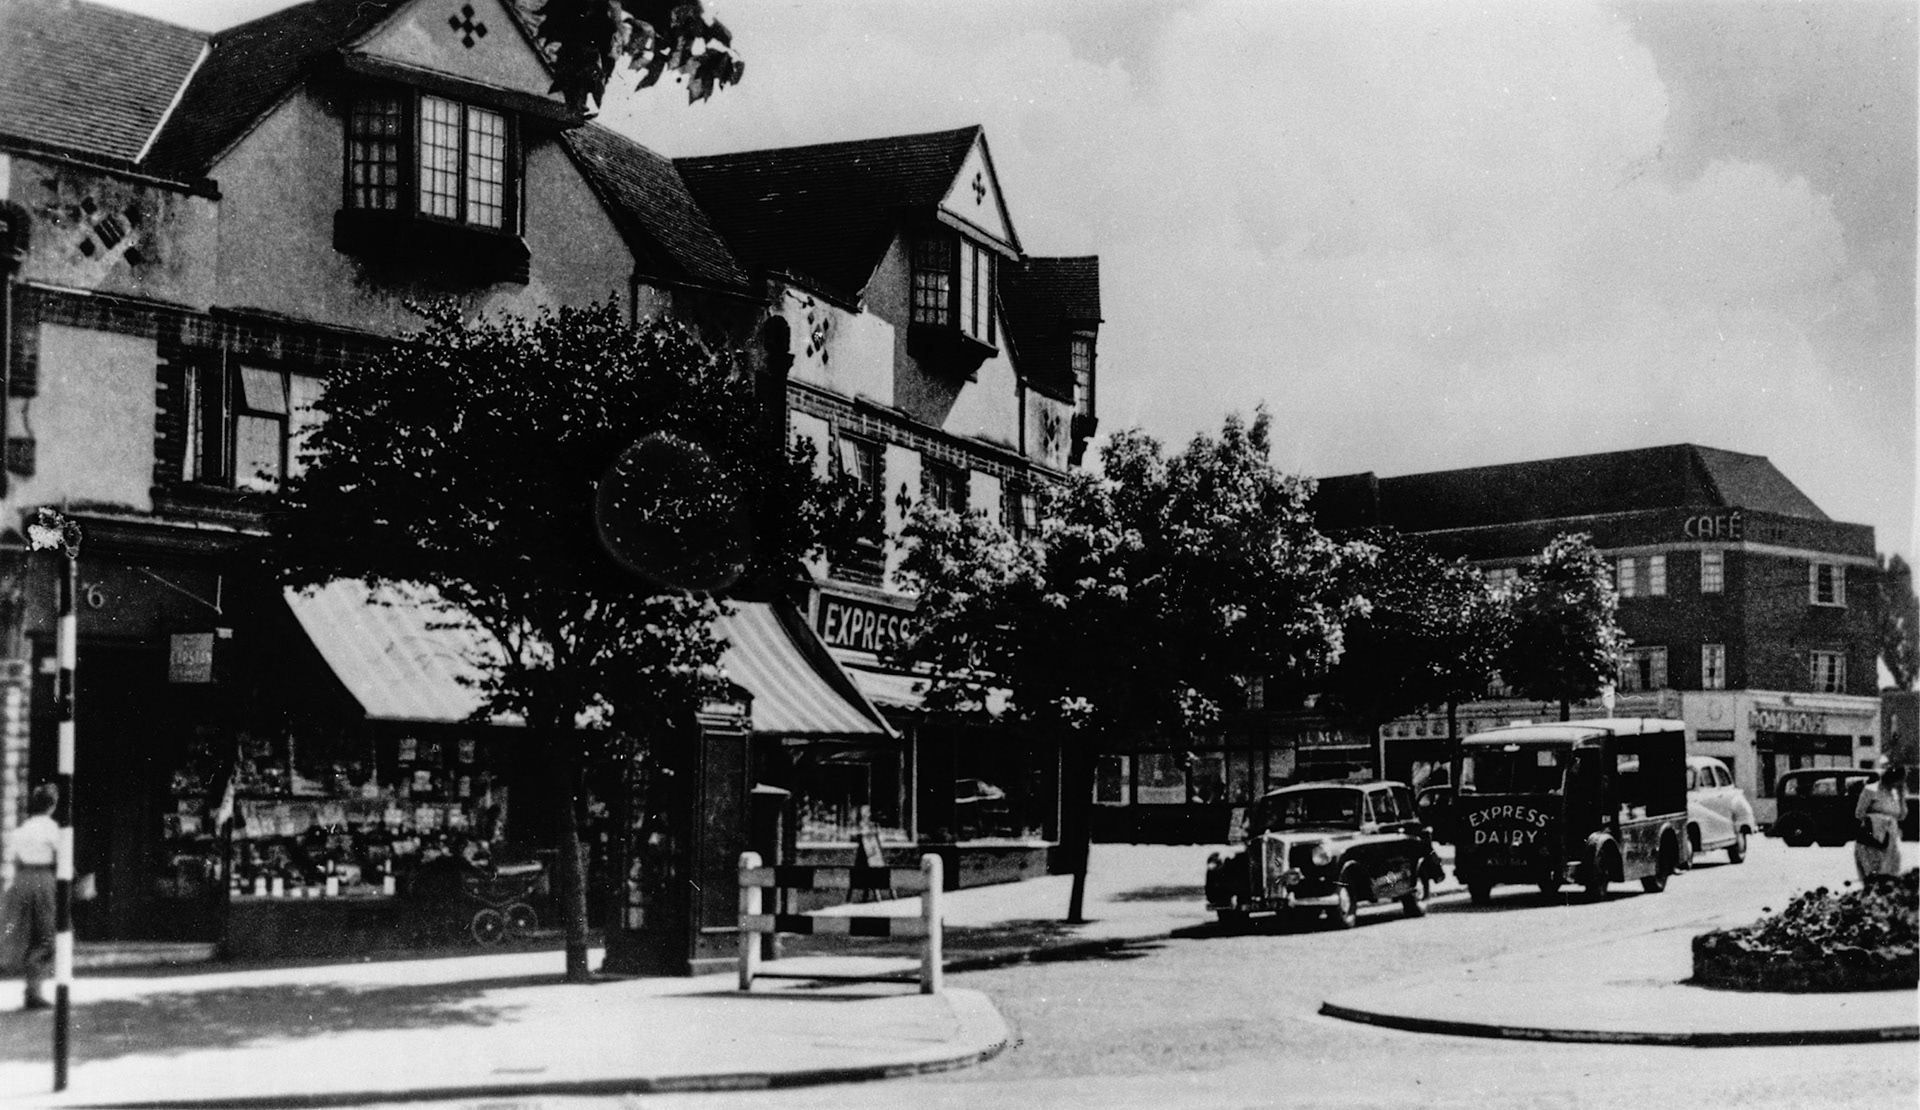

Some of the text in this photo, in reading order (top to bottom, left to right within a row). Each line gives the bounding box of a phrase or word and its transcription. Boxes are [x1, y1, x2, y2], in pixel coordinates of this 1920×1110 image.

[1684, 510, 1741, 538] CAFÉ
[87, 584, 105, 609] 6
[1469, 805, 1549, 828] EXPRESS
[1475, 830, 1538, 846] DAIRY
